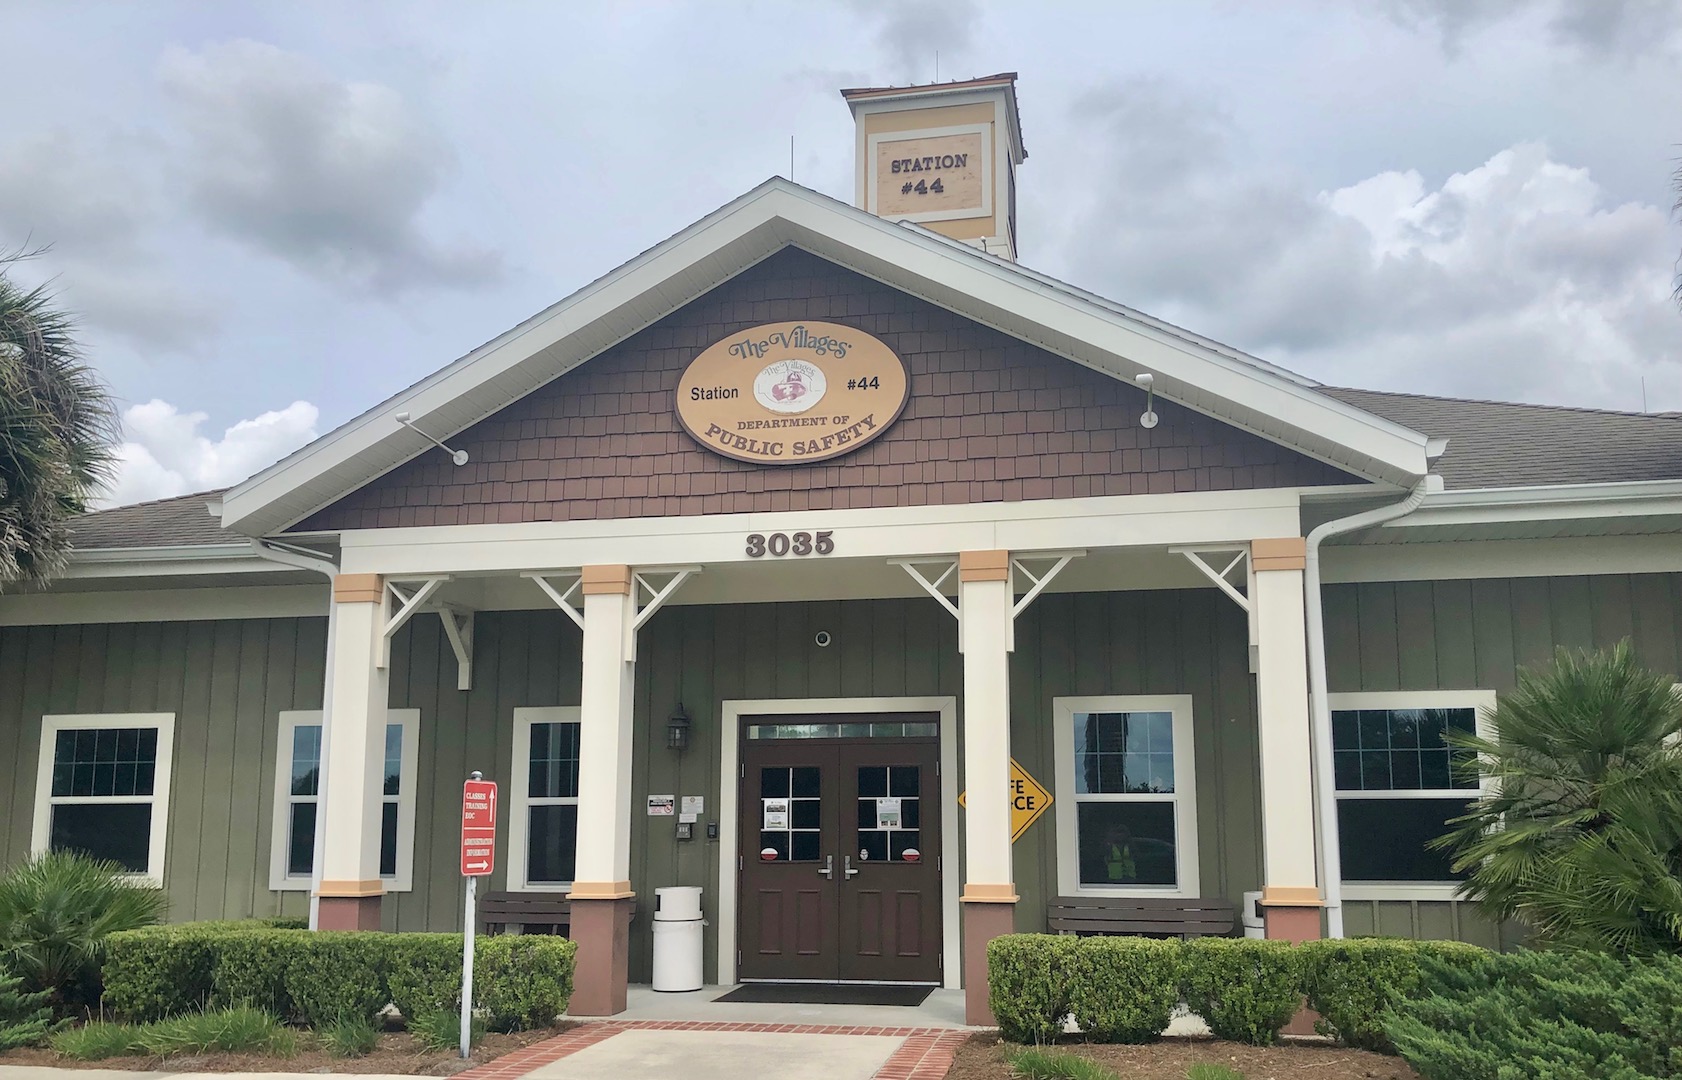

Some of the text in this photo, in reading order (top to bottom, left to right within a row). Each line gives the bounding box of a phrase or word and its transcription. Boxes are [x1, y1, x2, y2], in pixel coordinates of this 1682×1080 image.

[891, 153, 968, 174] STATION
[901, 177, 944, 195] #44
[728, 325, 849, 360] The Villages
[690, 376, 880, 401] Station #44
[704, 413, 877, 456] PUBLIC SAFETY
[737, 415, 850, 431] DEPARTMENT OF
[745, 530, 835, 558] 3035
[465, 802, 488, 810] TRAINING
